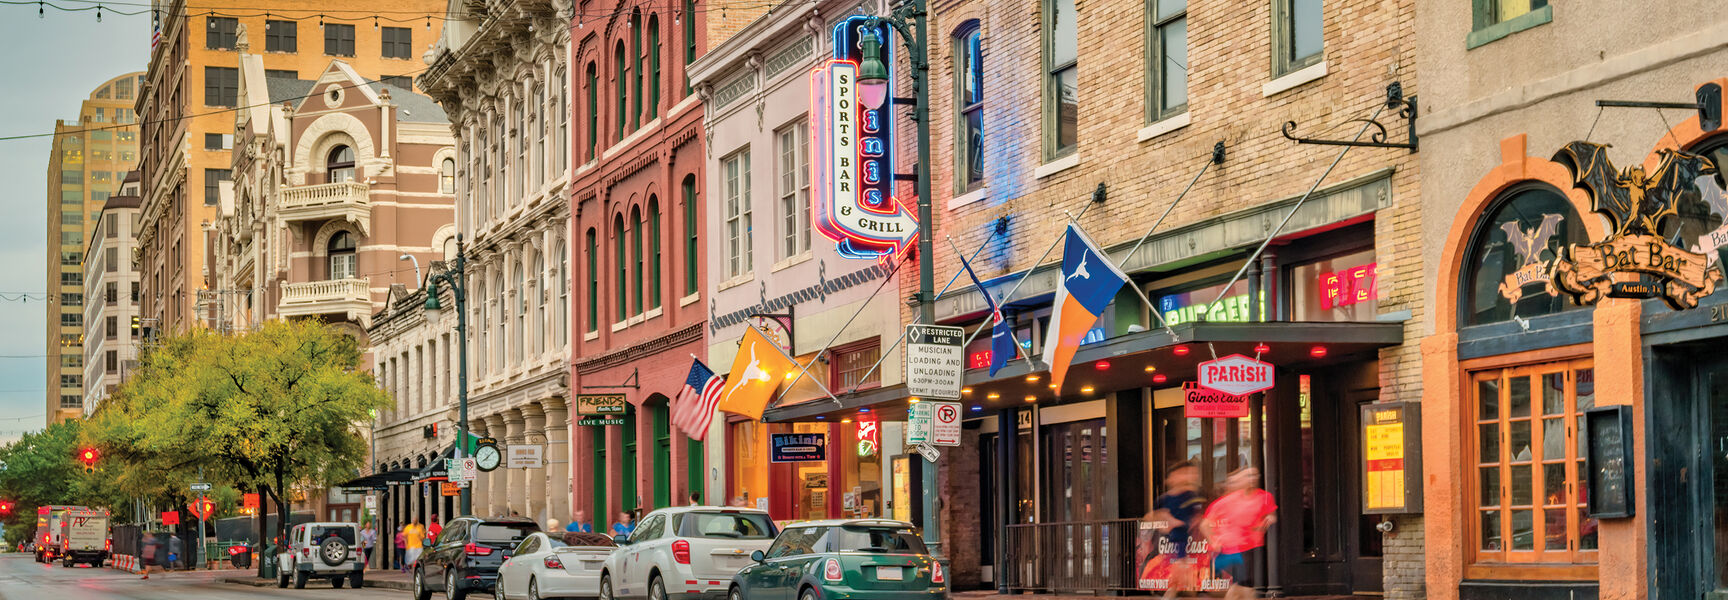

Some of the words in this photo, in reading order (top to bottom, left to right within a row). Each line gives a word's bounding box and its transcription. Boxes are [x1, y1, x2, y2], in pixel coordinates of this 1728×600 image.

[839, 75, 849, 146] SPORTS
[840, 157, 850, 192] BAR
[841, 206, 852, 216] &
[858, 218, 904, 232] GRILL
[1711, 231, 1728, 247] Ba
[1601, 244, 1640, 270] Bat
[1650, 240, 1687, 273] Bar
[1515, 270, 1532, 286] Bat
[1621, 284, 1650, 294] Austin,
[1165, 290, 1265, 327] BURGER
[1711, 304, 1728, 322] 21
[921, 328, 962, 337] RESTRICTED
[933, 336, 951, 344] LANE
[918, 346, 952, 354] MUSICIAN
[909, 357, 941, 365] LOADING
[914, 367, 956, 377] UNLOADING
[931, 388, 959, 397] REQUIRED
[1188, 391, 1219, 403] Gino's
[580, 397, 624, 406] FRIENDS
[1018, 411, 1031, 425] 14
[775, 435, 823, 447] Bikinis
[1185, 536, 1209, 554] East
[1139, 578, 1168, 589] CARRYOUT
[1202, 579, 1230, 590] DELIVERY
